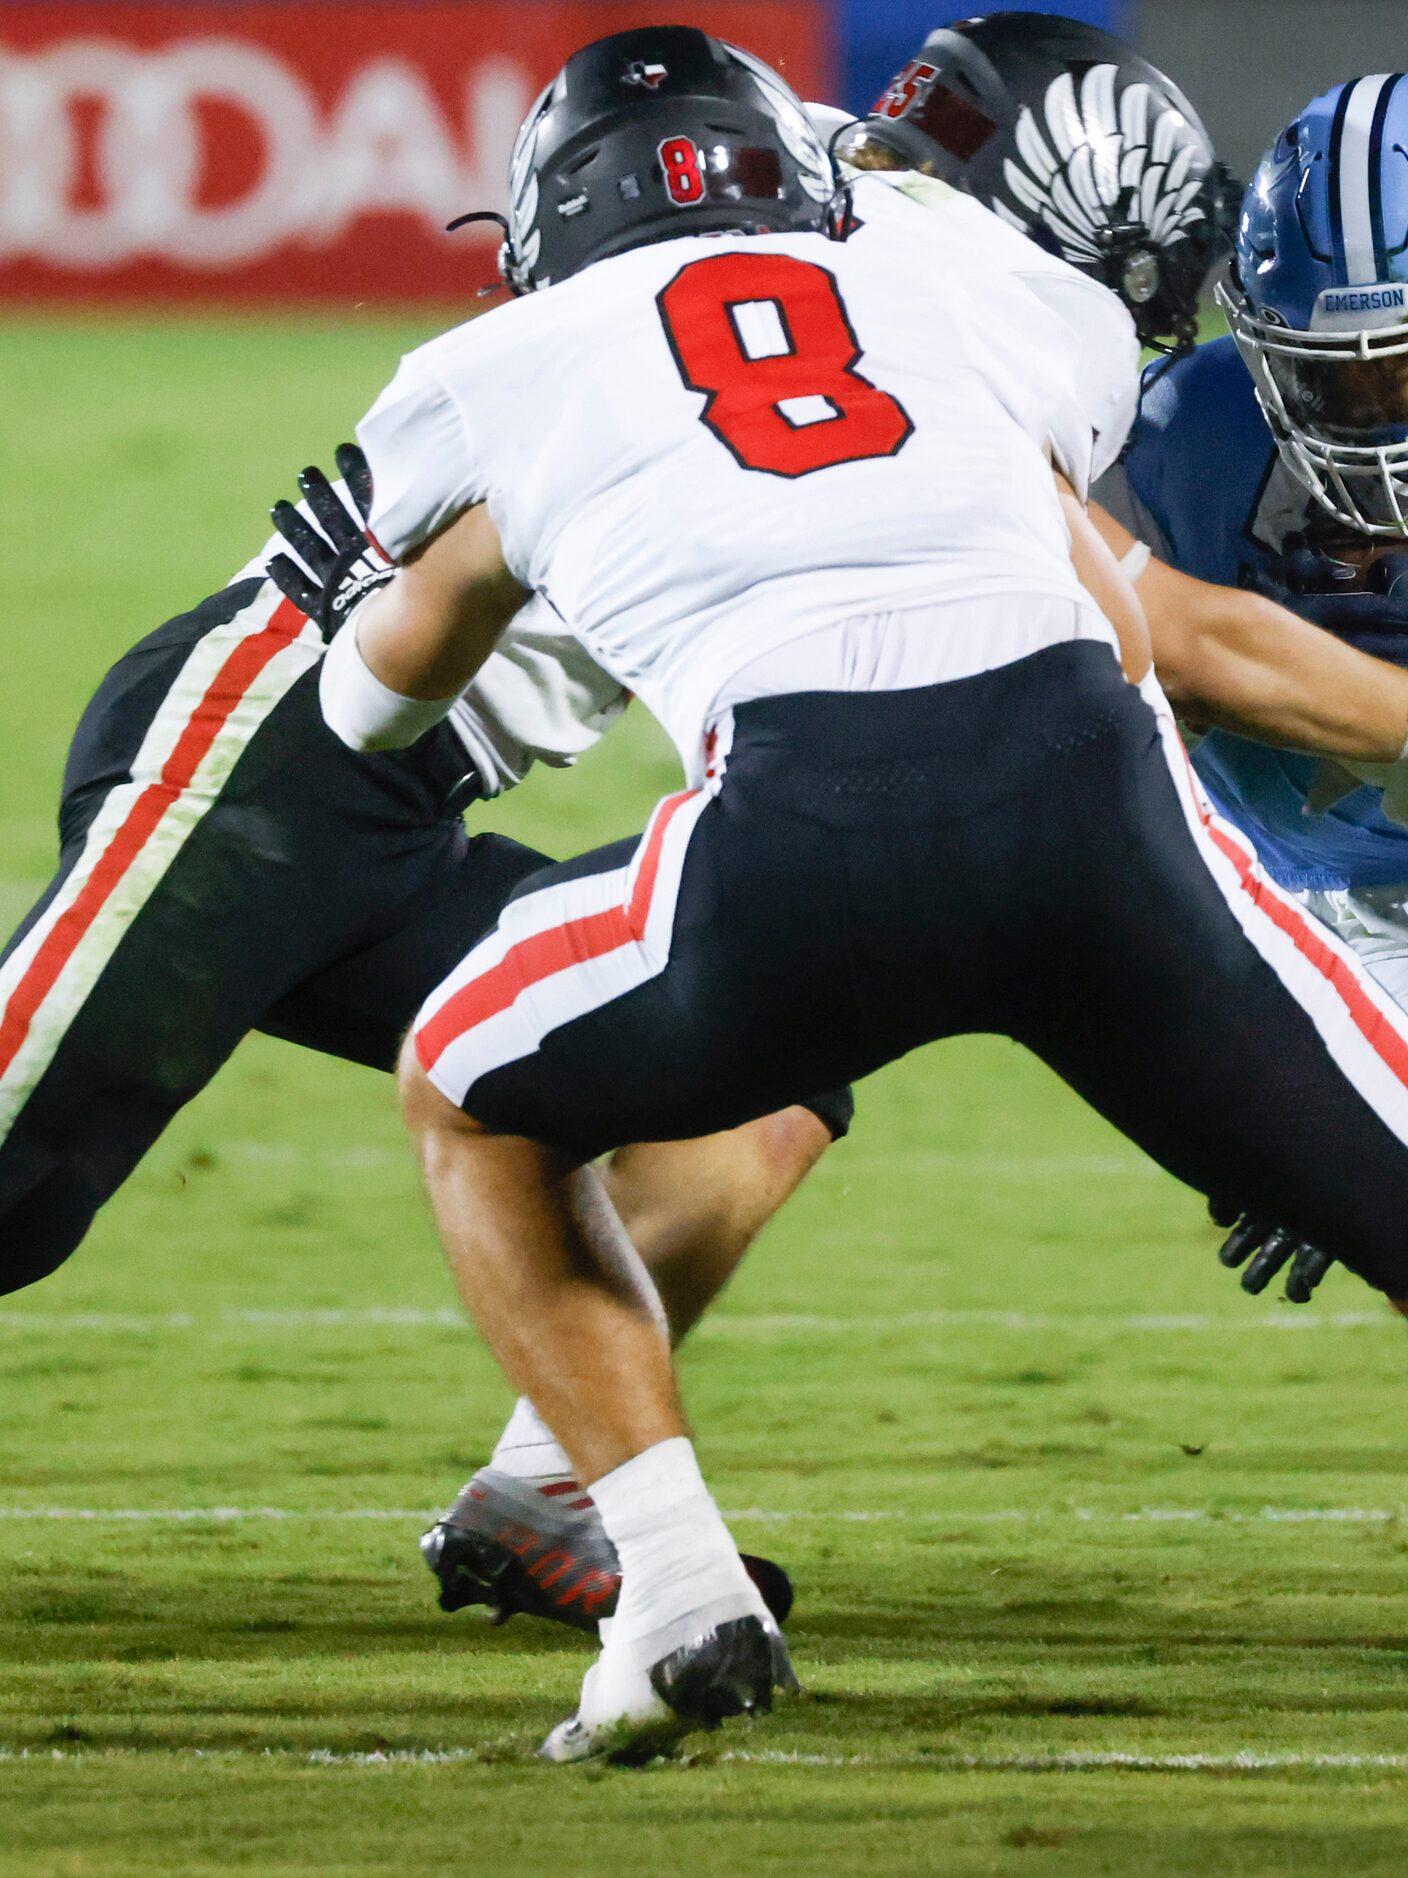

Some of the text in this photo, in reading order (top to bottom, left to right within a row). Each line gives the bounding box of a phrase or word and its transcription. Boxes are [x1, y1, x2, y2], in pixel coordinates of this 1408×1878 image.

[657, 135, 706, 206] 8
[1325, 289, 1404, 312] EMERSON
[655, 251, 915, 479] 8
